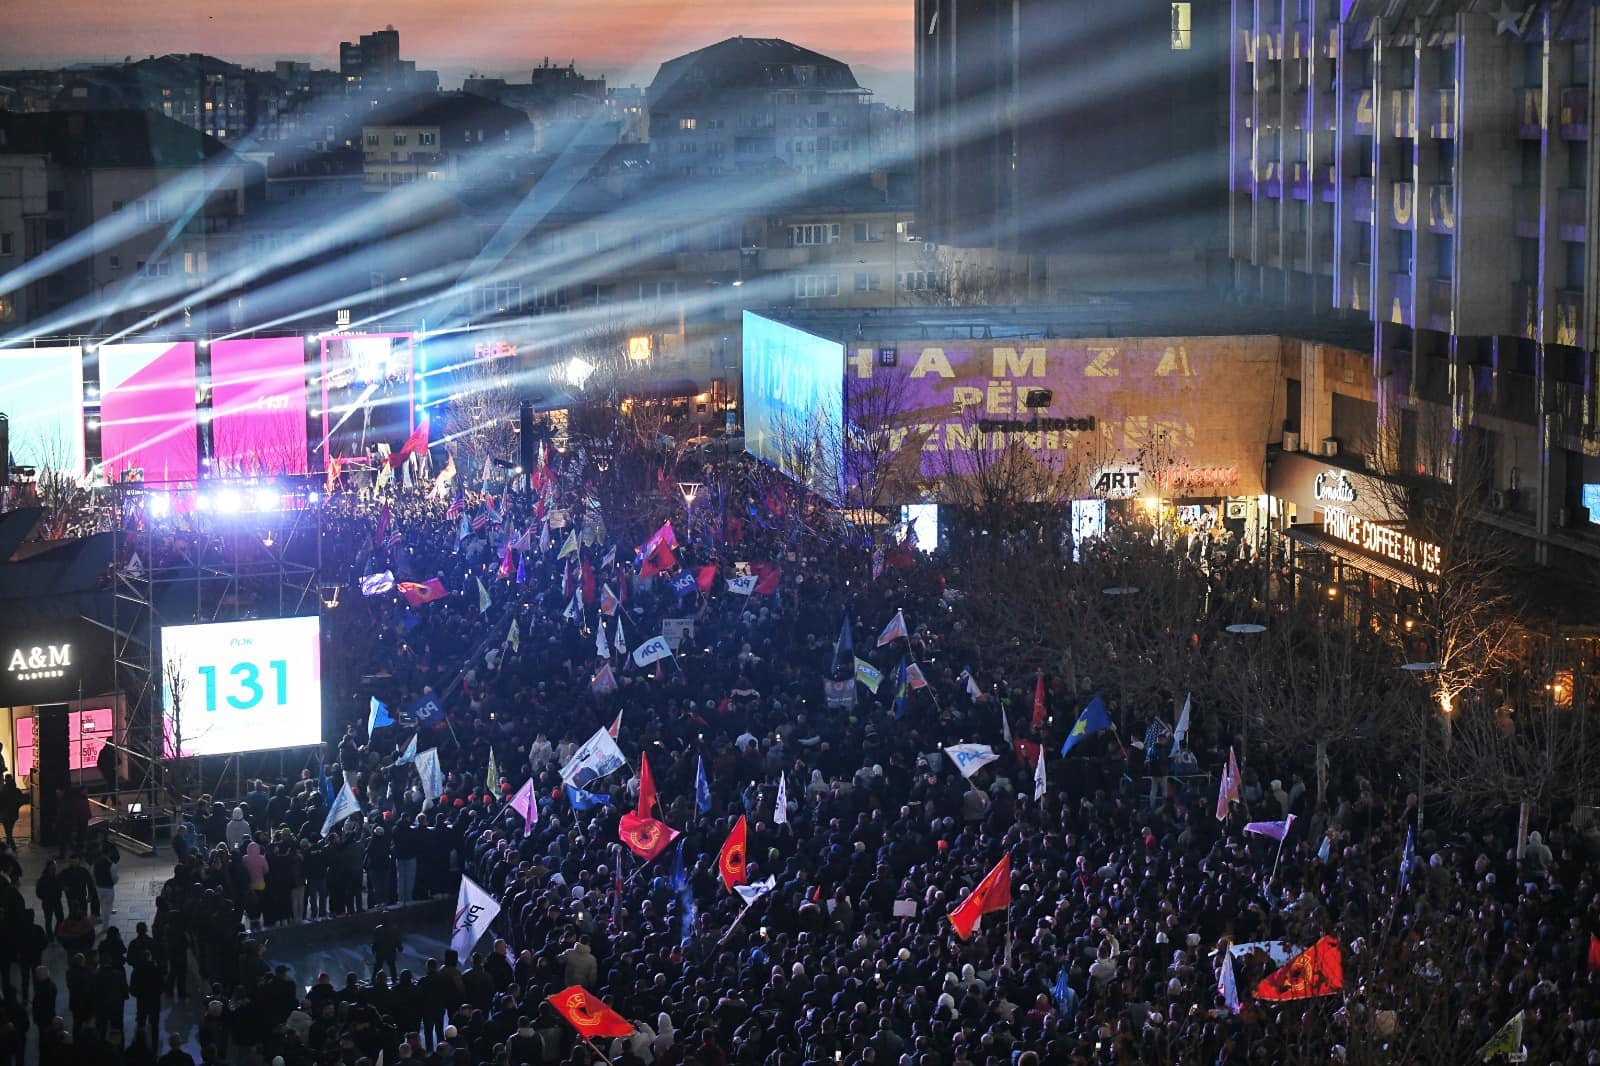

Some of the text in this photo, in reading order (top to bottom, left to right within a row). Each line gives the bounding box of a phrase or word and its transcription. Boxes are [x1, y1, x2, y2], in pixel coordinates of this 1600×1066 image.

[1094, 471, 1139, 492] ART
[1323, 505, 1361, 545] PRINCE
[1362, 520, 1402, 561] COFFEE
[8, 643, 72, 672] A&M
[198, 659, 288, 713] 131
